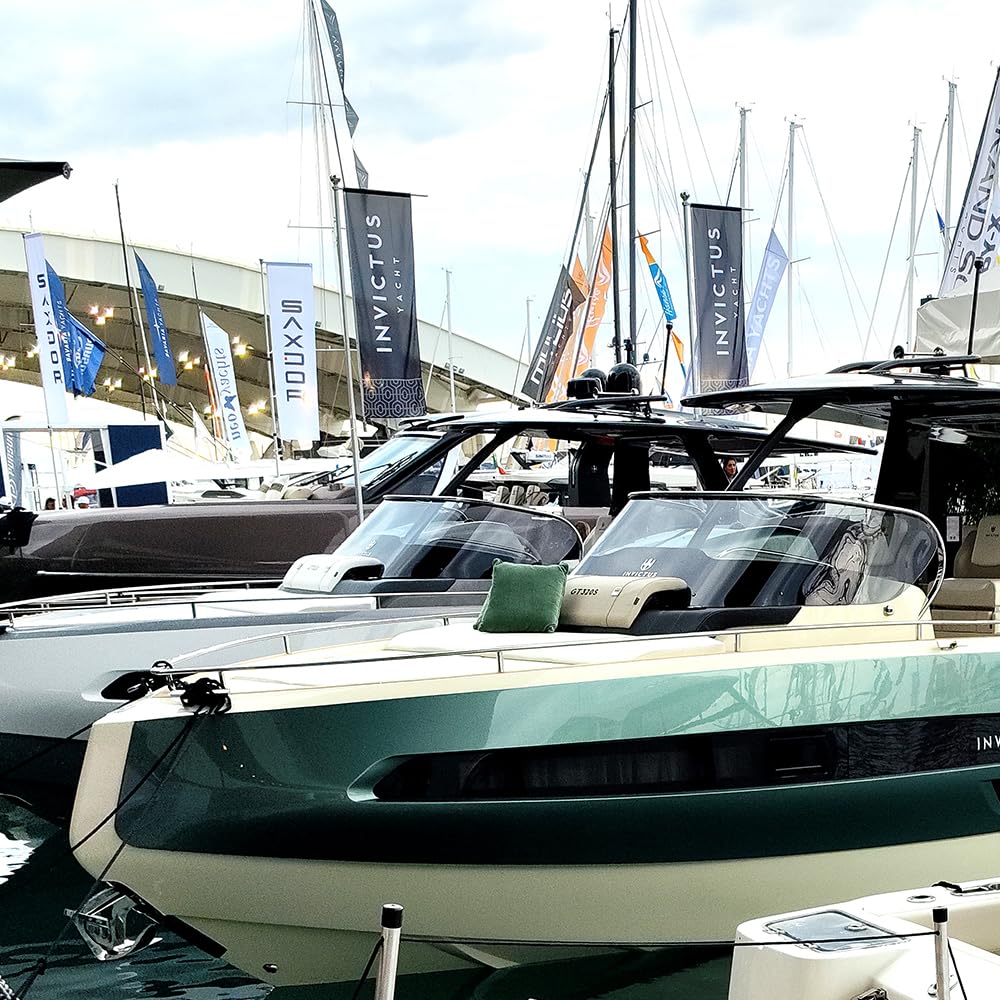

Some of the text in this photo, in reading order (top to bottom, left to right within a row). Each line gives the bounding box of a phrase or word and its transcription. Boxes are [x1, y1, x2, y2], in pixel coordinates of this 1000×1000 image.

[366, 214, 393, 354] INVICTUS
[393, 256, 405, 313] YACHT
[708, 227, 729, 356] INVICTUS
[730, 266, 739, 319] YACHT
